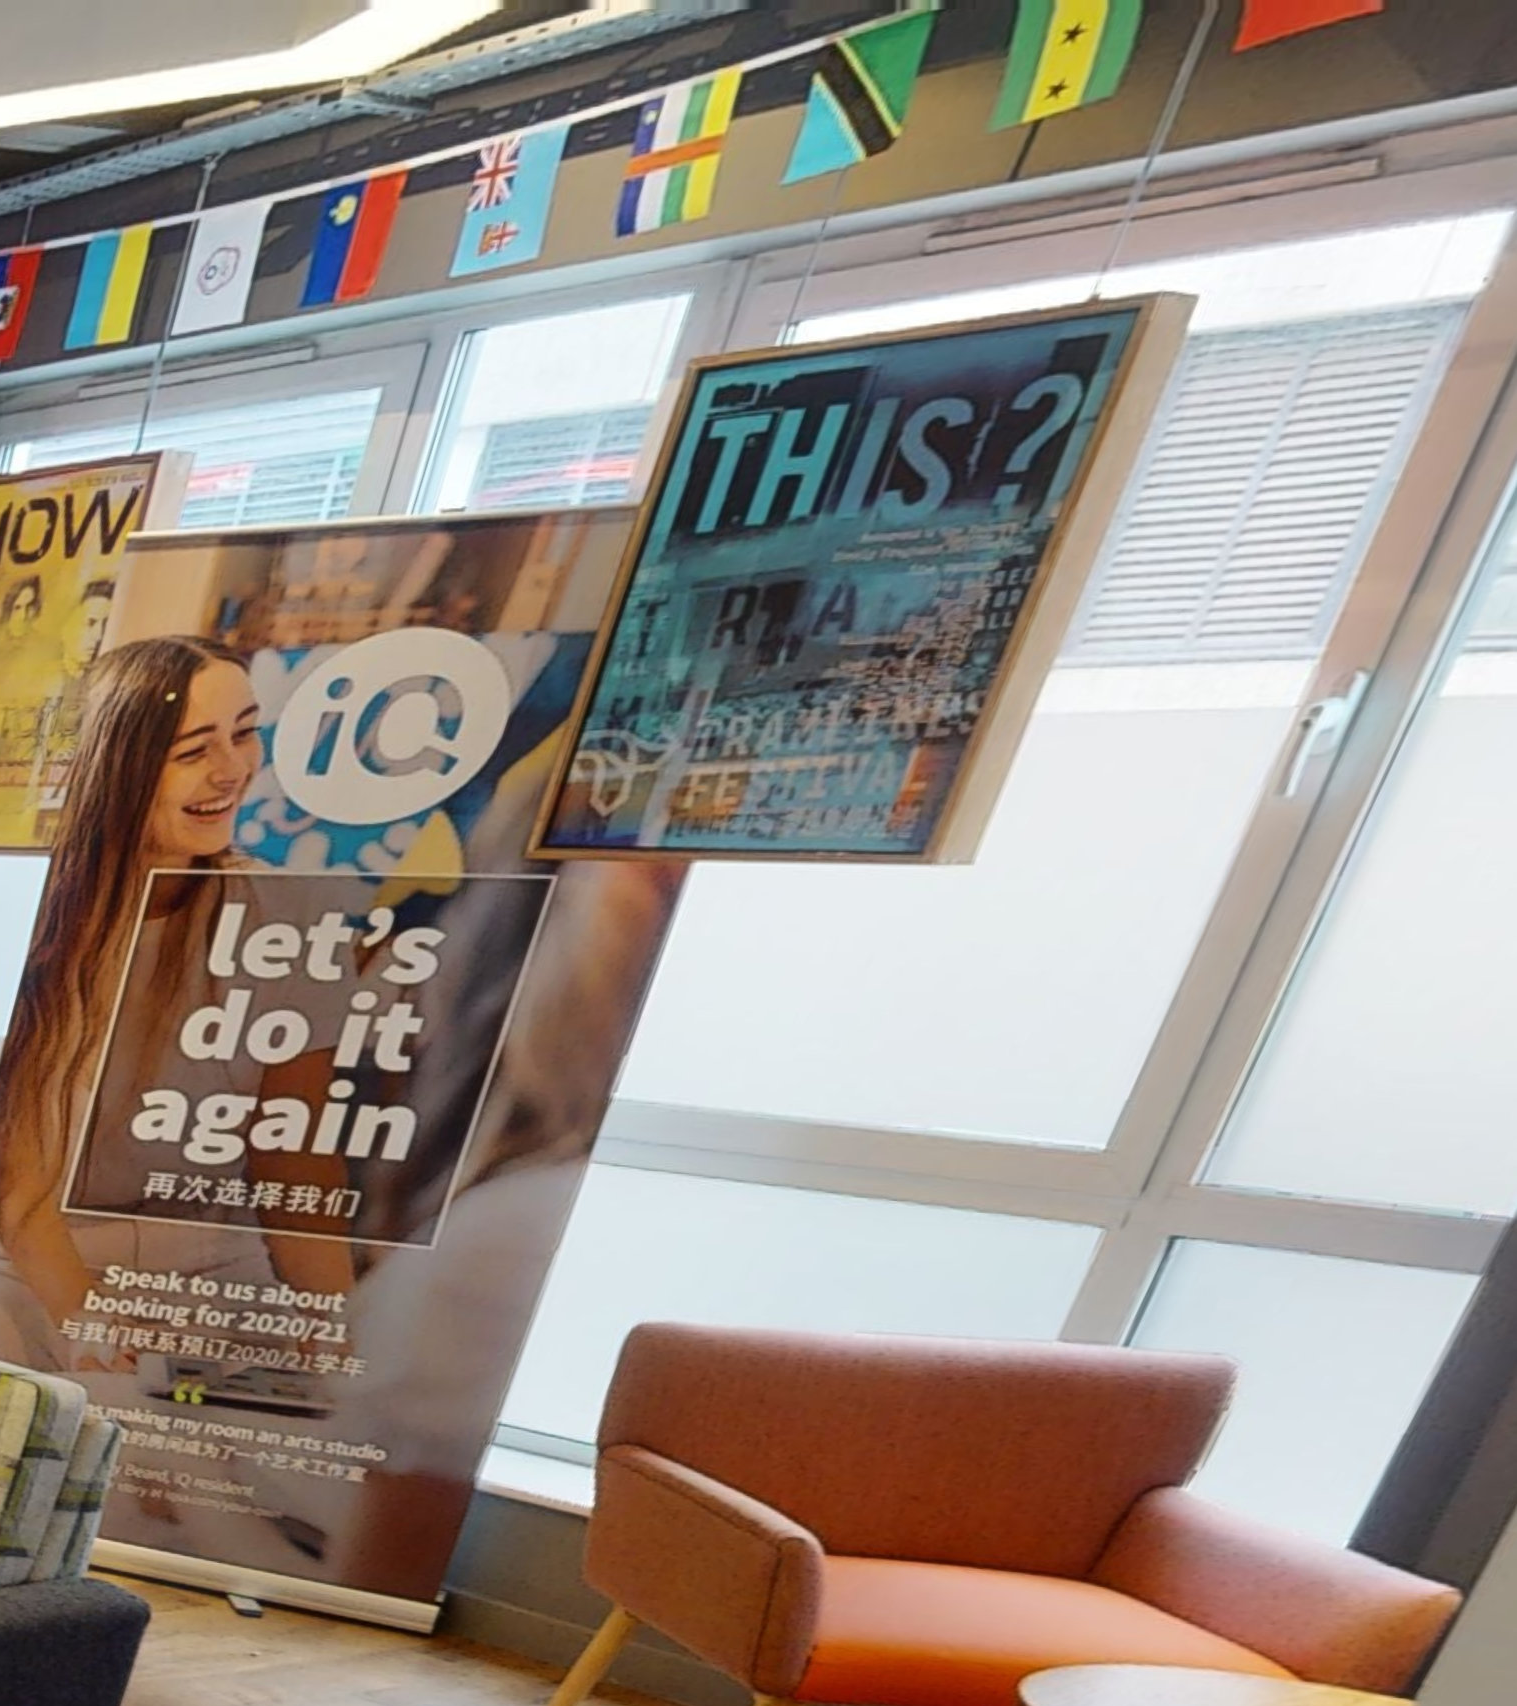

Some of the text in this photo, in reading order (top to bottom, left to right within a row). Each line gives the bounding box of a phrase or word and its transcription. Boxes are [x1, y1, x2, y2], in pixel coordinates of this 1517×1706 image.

[306, 675, 464, 778] iQ
[208, 903, 447, 985] let's
[179, 989, 424, 1072] do it
[131, 1079, 417, 1165] again
[143, 1172, 362, 1219] 再次选择我们
[83, 1290, 347, 1344] booking for 2020/21
[103, 1264, 347, 1313] Speak to us about
[106, 1406, 171, 1431] making
[173, 1417, 203, 1435] my
[204, 1422, 254, 1441] room
[256, 1429, 282, 1445] an
[283, 1435, 324, 1451] arts
[325, 1441, 387, 1461] studio
